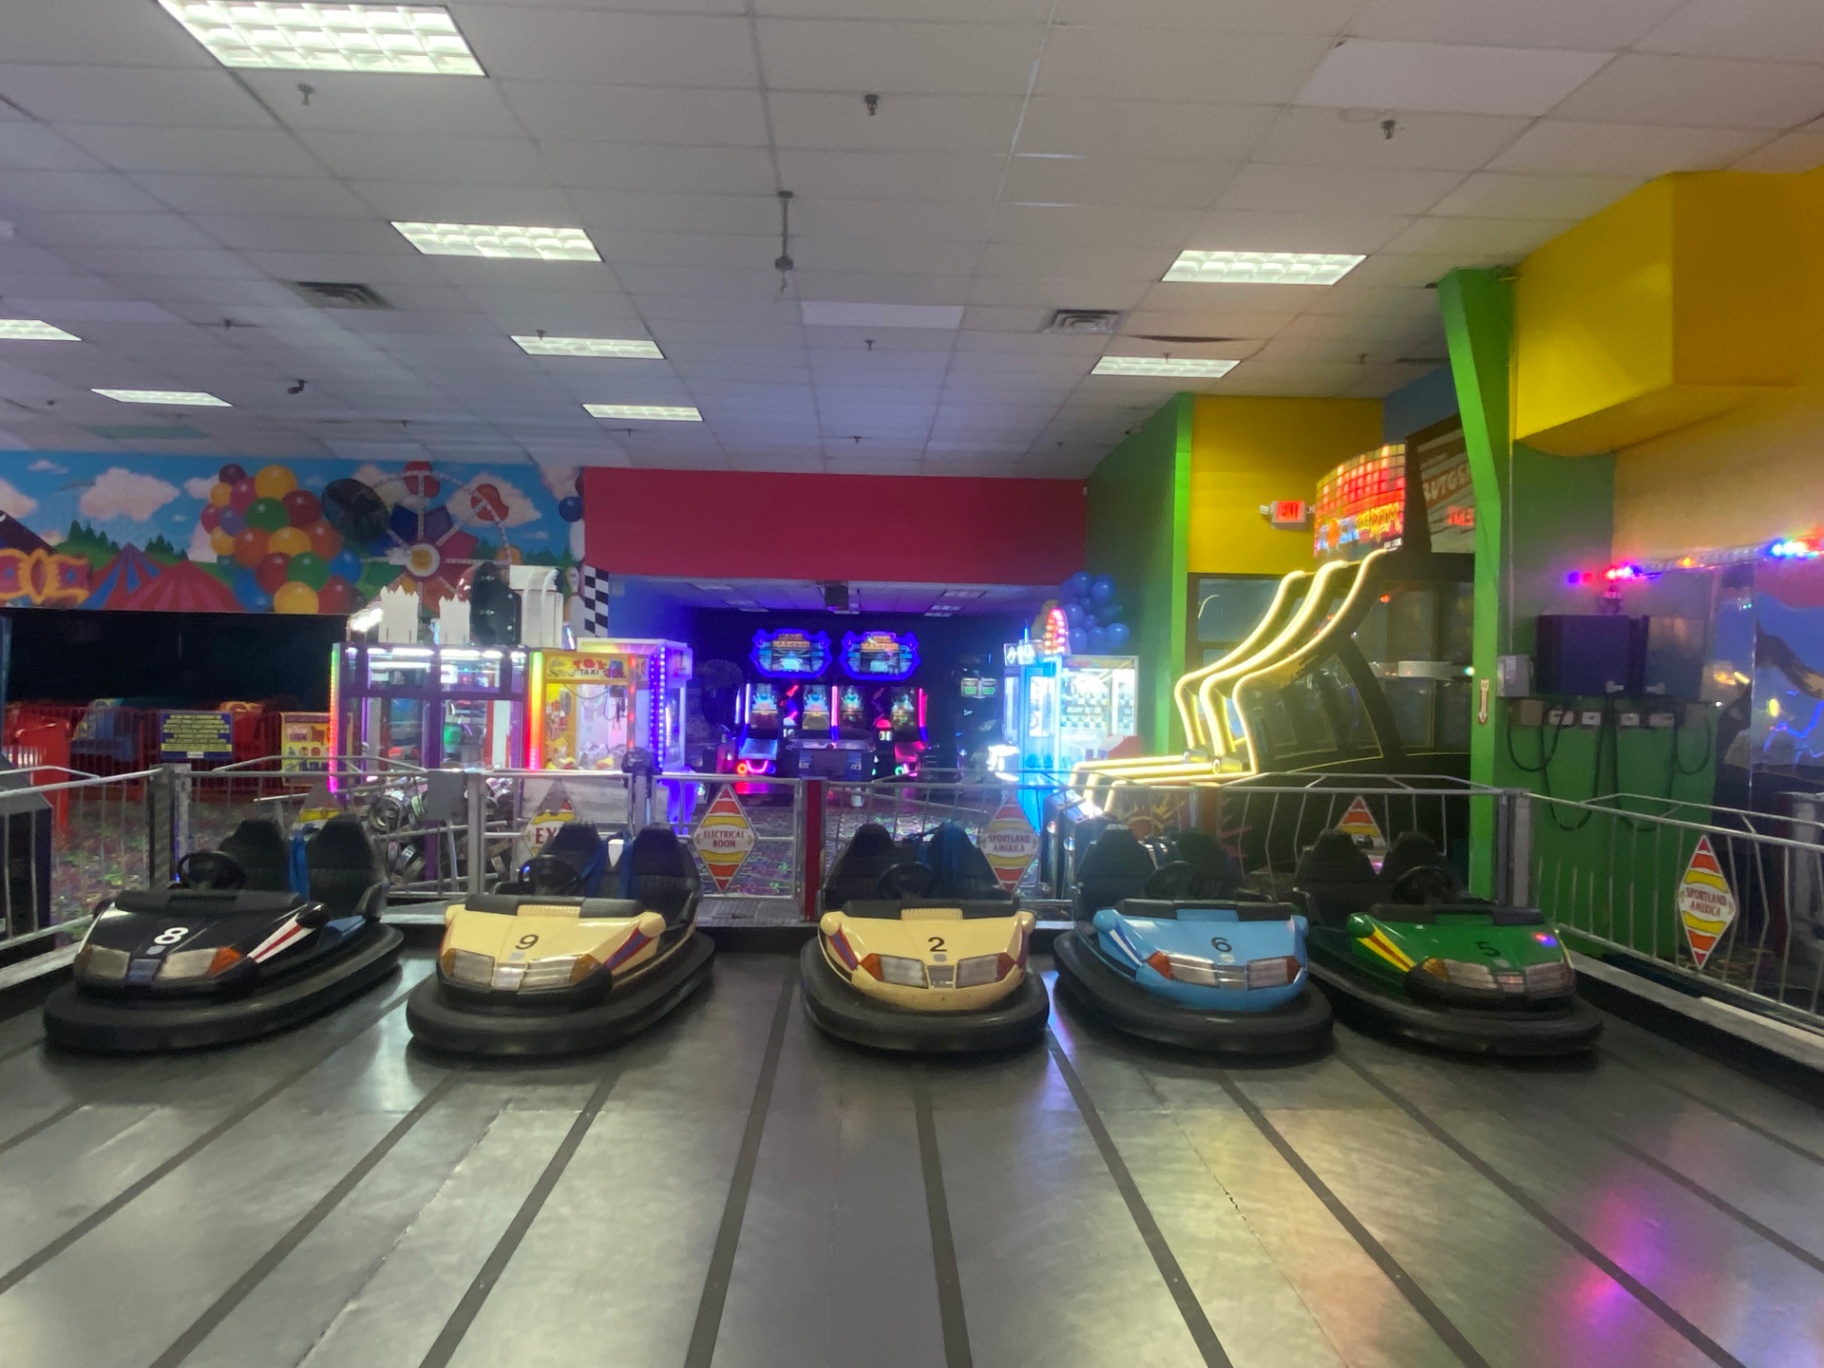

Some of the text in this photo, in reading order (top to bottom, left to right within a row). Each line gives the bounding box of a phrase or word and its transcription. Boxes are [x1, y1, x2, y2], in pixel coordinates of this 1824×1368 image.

[580, 668, 599, 676] TAXI
[703, 829, 746, 839] ELECTRICAL
[988, 833, 1031, 844] SPORTLAND
[712, 839, 737, 848] ROOM
[992, 843, 1026, 853] AMERICA
[1685, 886, 1728, 907] SPORTLAND
[1689, 900, 1721, 917] AMERICA
[153, 926, 189, 945] 8
[514, 933, 540, 951] 9
[927, 936, 948, 953] 2
[1210, 936, 1233, 953] 6
[1475, 941, 1501, 957] 5
